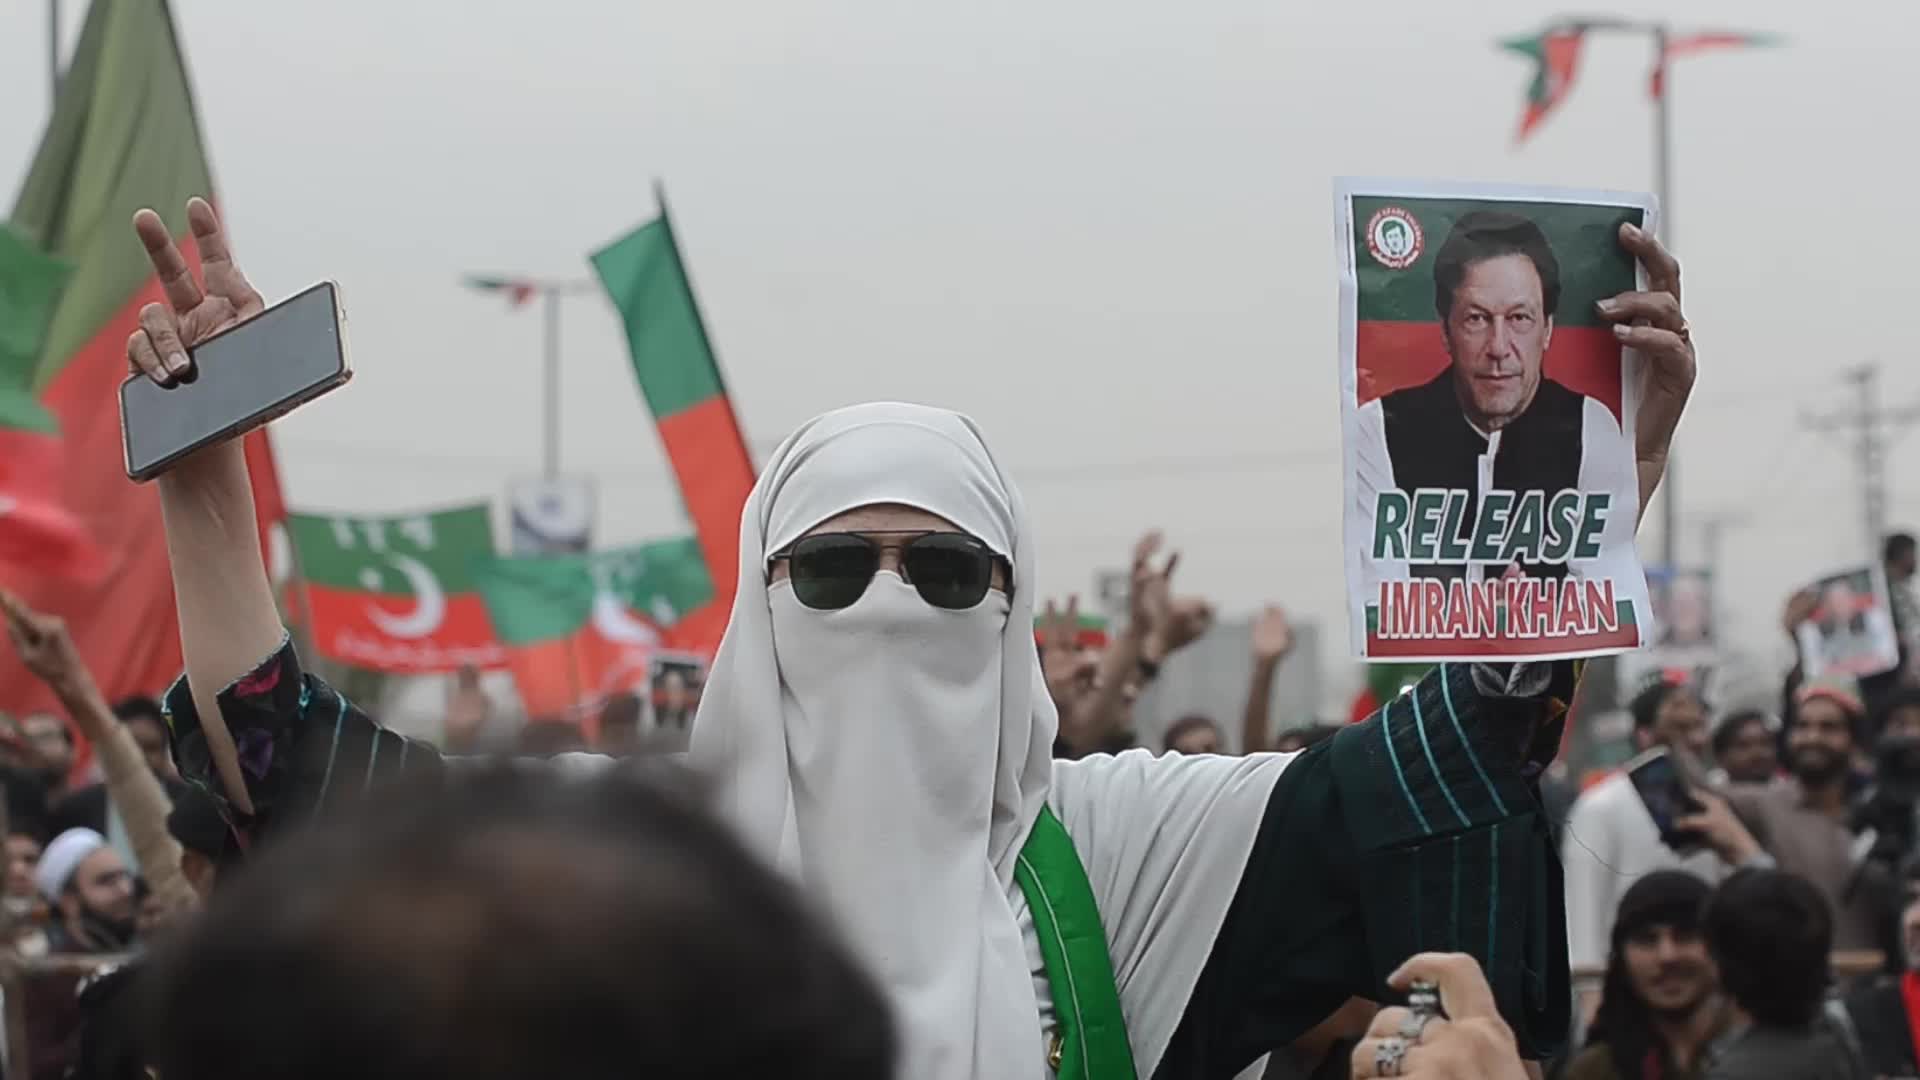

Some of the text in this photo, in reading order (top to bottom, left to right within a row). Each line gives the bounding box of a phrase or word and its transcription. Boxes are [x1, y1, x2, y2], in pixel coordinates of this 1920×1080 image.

[1372, 490, 1611, 562] RELEASE
[1377, 577, 1617, 638] IMRAN KHAN
